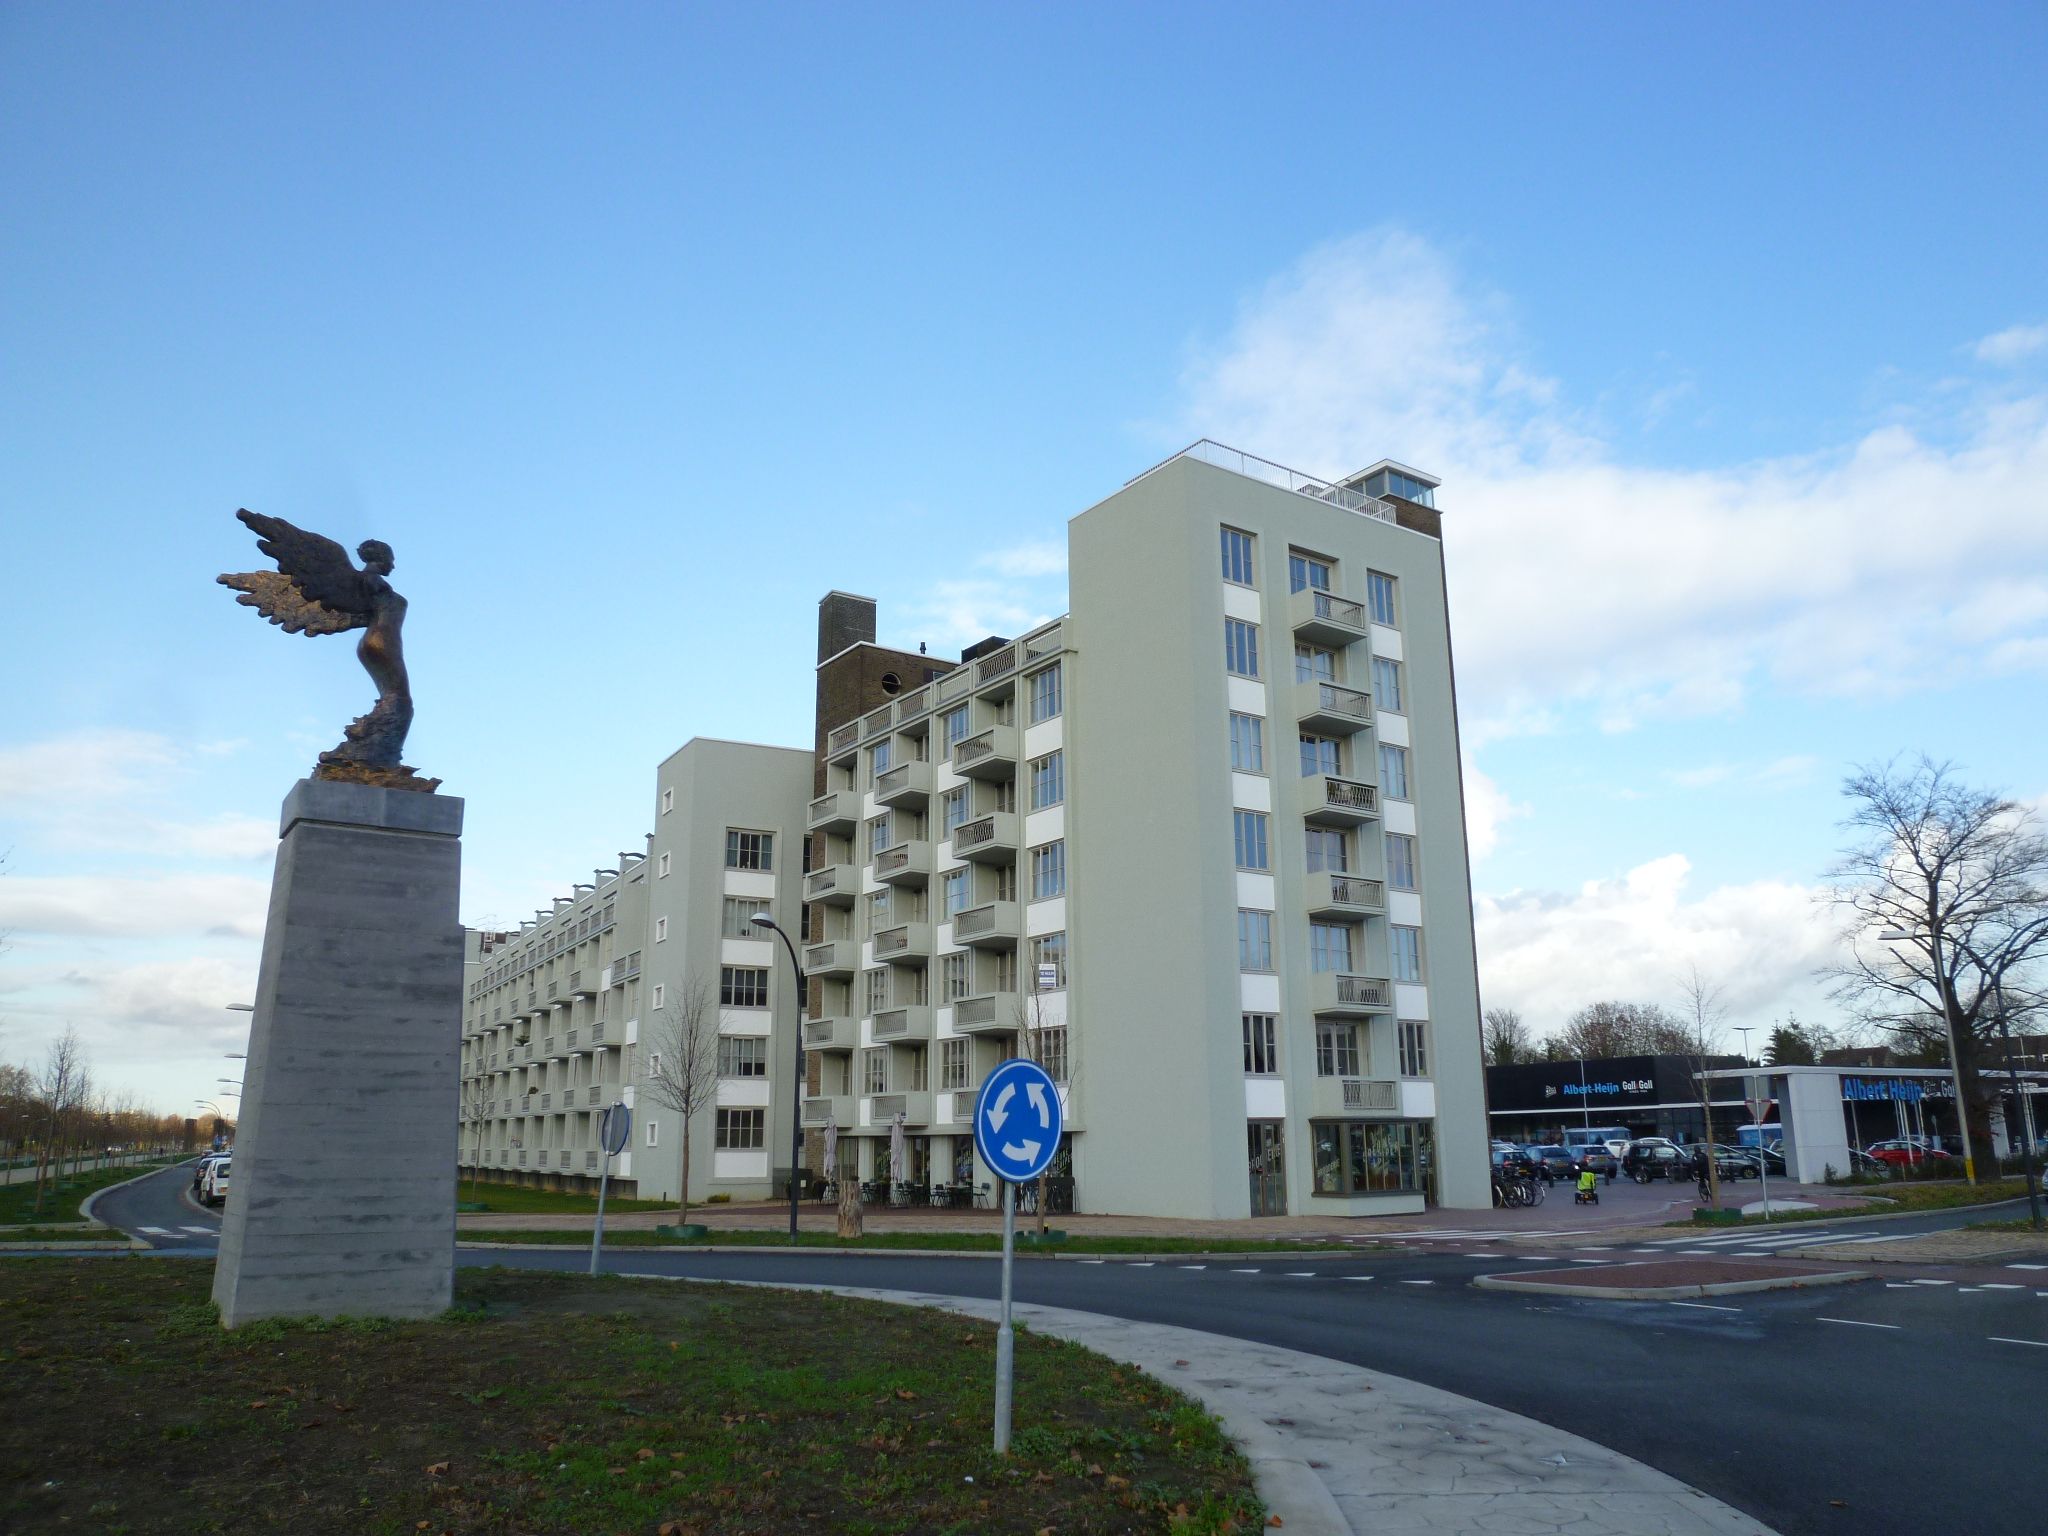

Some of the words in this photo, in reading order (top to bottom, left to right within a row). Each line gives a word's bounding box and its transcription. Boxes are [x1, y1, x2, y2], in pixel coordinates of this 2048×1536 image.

[1563, 1084, 1593, 1095] Albert
[1594, 1082, 1619, 1095] Heijn
[1622, 1081, 1636, 1090] Gall
[1638, 1080, 1653, 1089] Gall
[1844, 1079, 1888, 1100] Albert
[1888, 1079, 1922, 1104] Heijn
